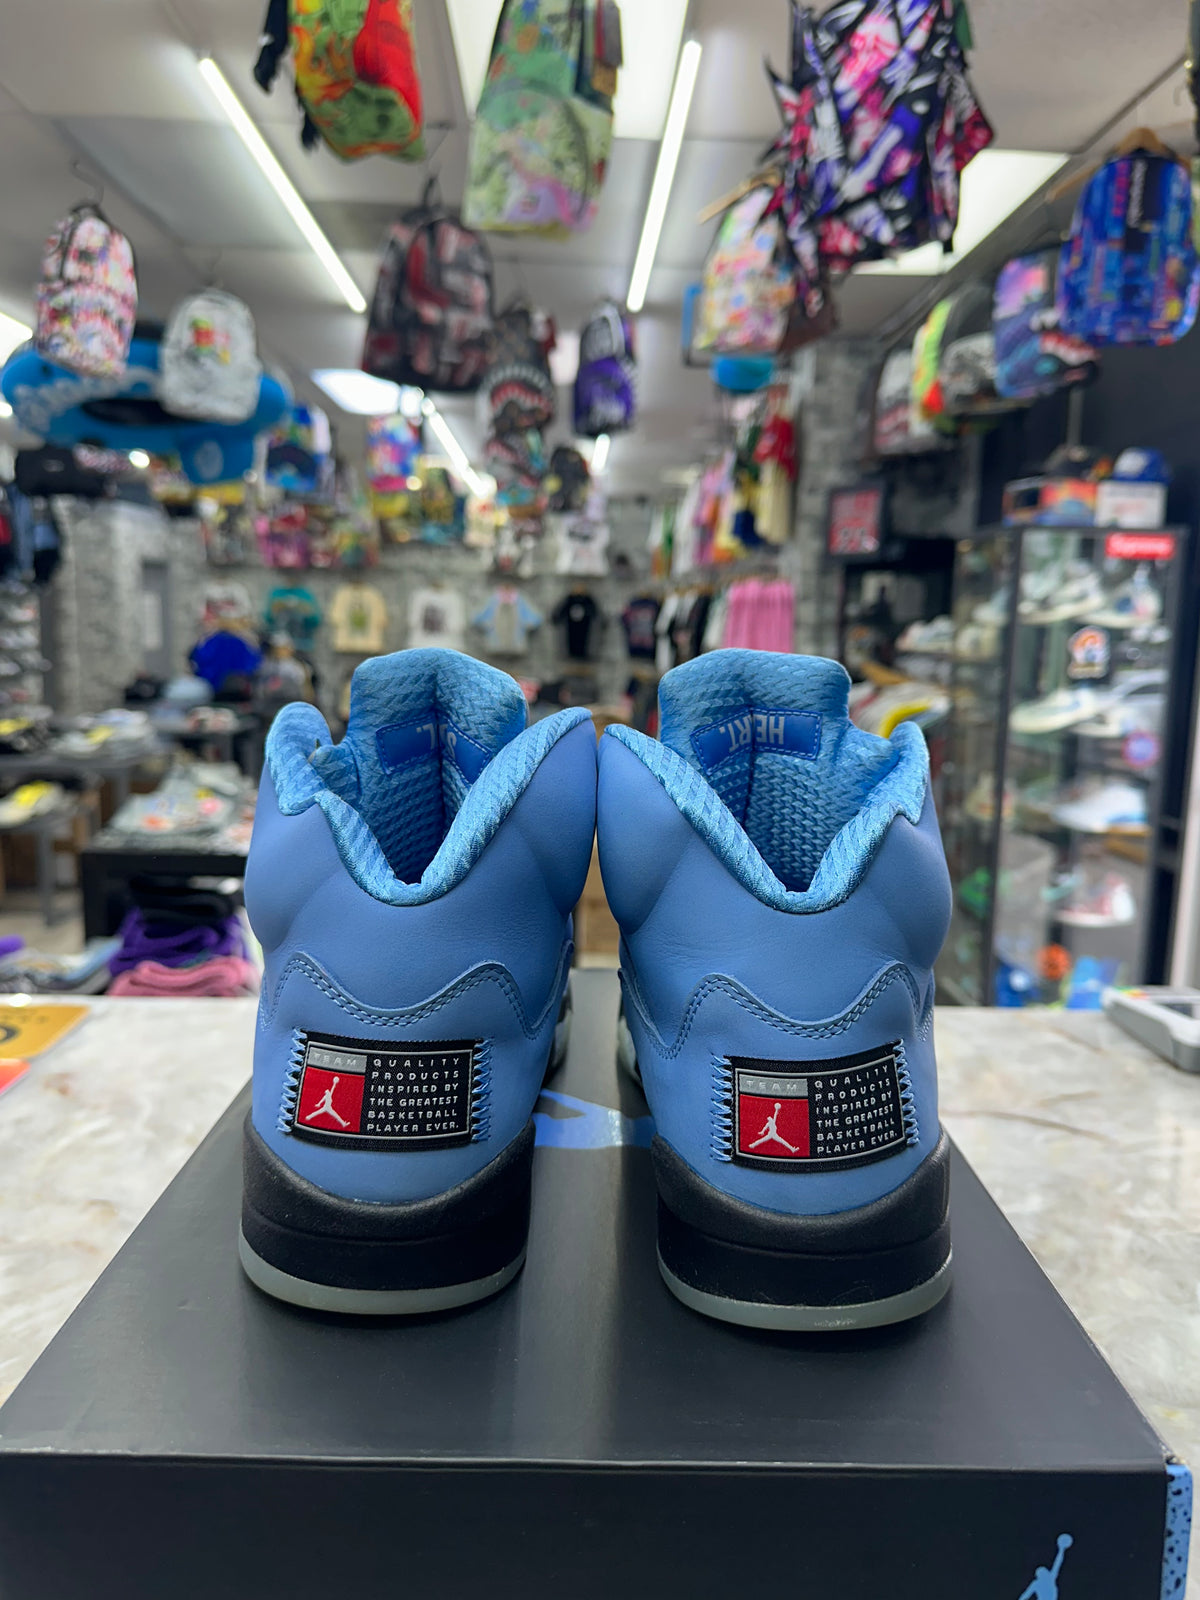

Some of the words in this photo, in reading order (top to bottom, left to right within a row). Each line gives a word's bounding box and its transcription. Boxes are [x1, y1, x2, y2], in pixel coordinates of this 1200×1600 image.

[313, 1052, 358, 1067] TEAM
[373, 1057, 460, 1068] QUALITY
[371, 1070, 460, 1081] PRODUCTS
[814, 1064, 889, 1089] QUALITY
[370, 1083, 438, 1094] INSPIRED
[444, 1083, 459, 1092] BY
[746, 1079, 798, 1092] TEAM
[815, 1078, 890, 1102] PRODUCTS
[369, 1097, 394, 1106] THE
[399, 1095, 459, 1107] GREATEST
[815, 1097, 876, 1115] INSPIRED
[881, 1090, 893, 1102] BY
[367, 1109, 458, 1120] BASKETBALL
[816, 1118, 840, 1128] THE
[845, 1104, 894, 1125] GREATEST
[366, 1123, 419, 1133] PLAYER
[426, 1121, 459, 1132] EVER.
[816, 1117, 895, 1141] BASKETBALL
[816, 1139, 865, 1154] PLAYER
[871, 1130, 898, 1145] EVER.
